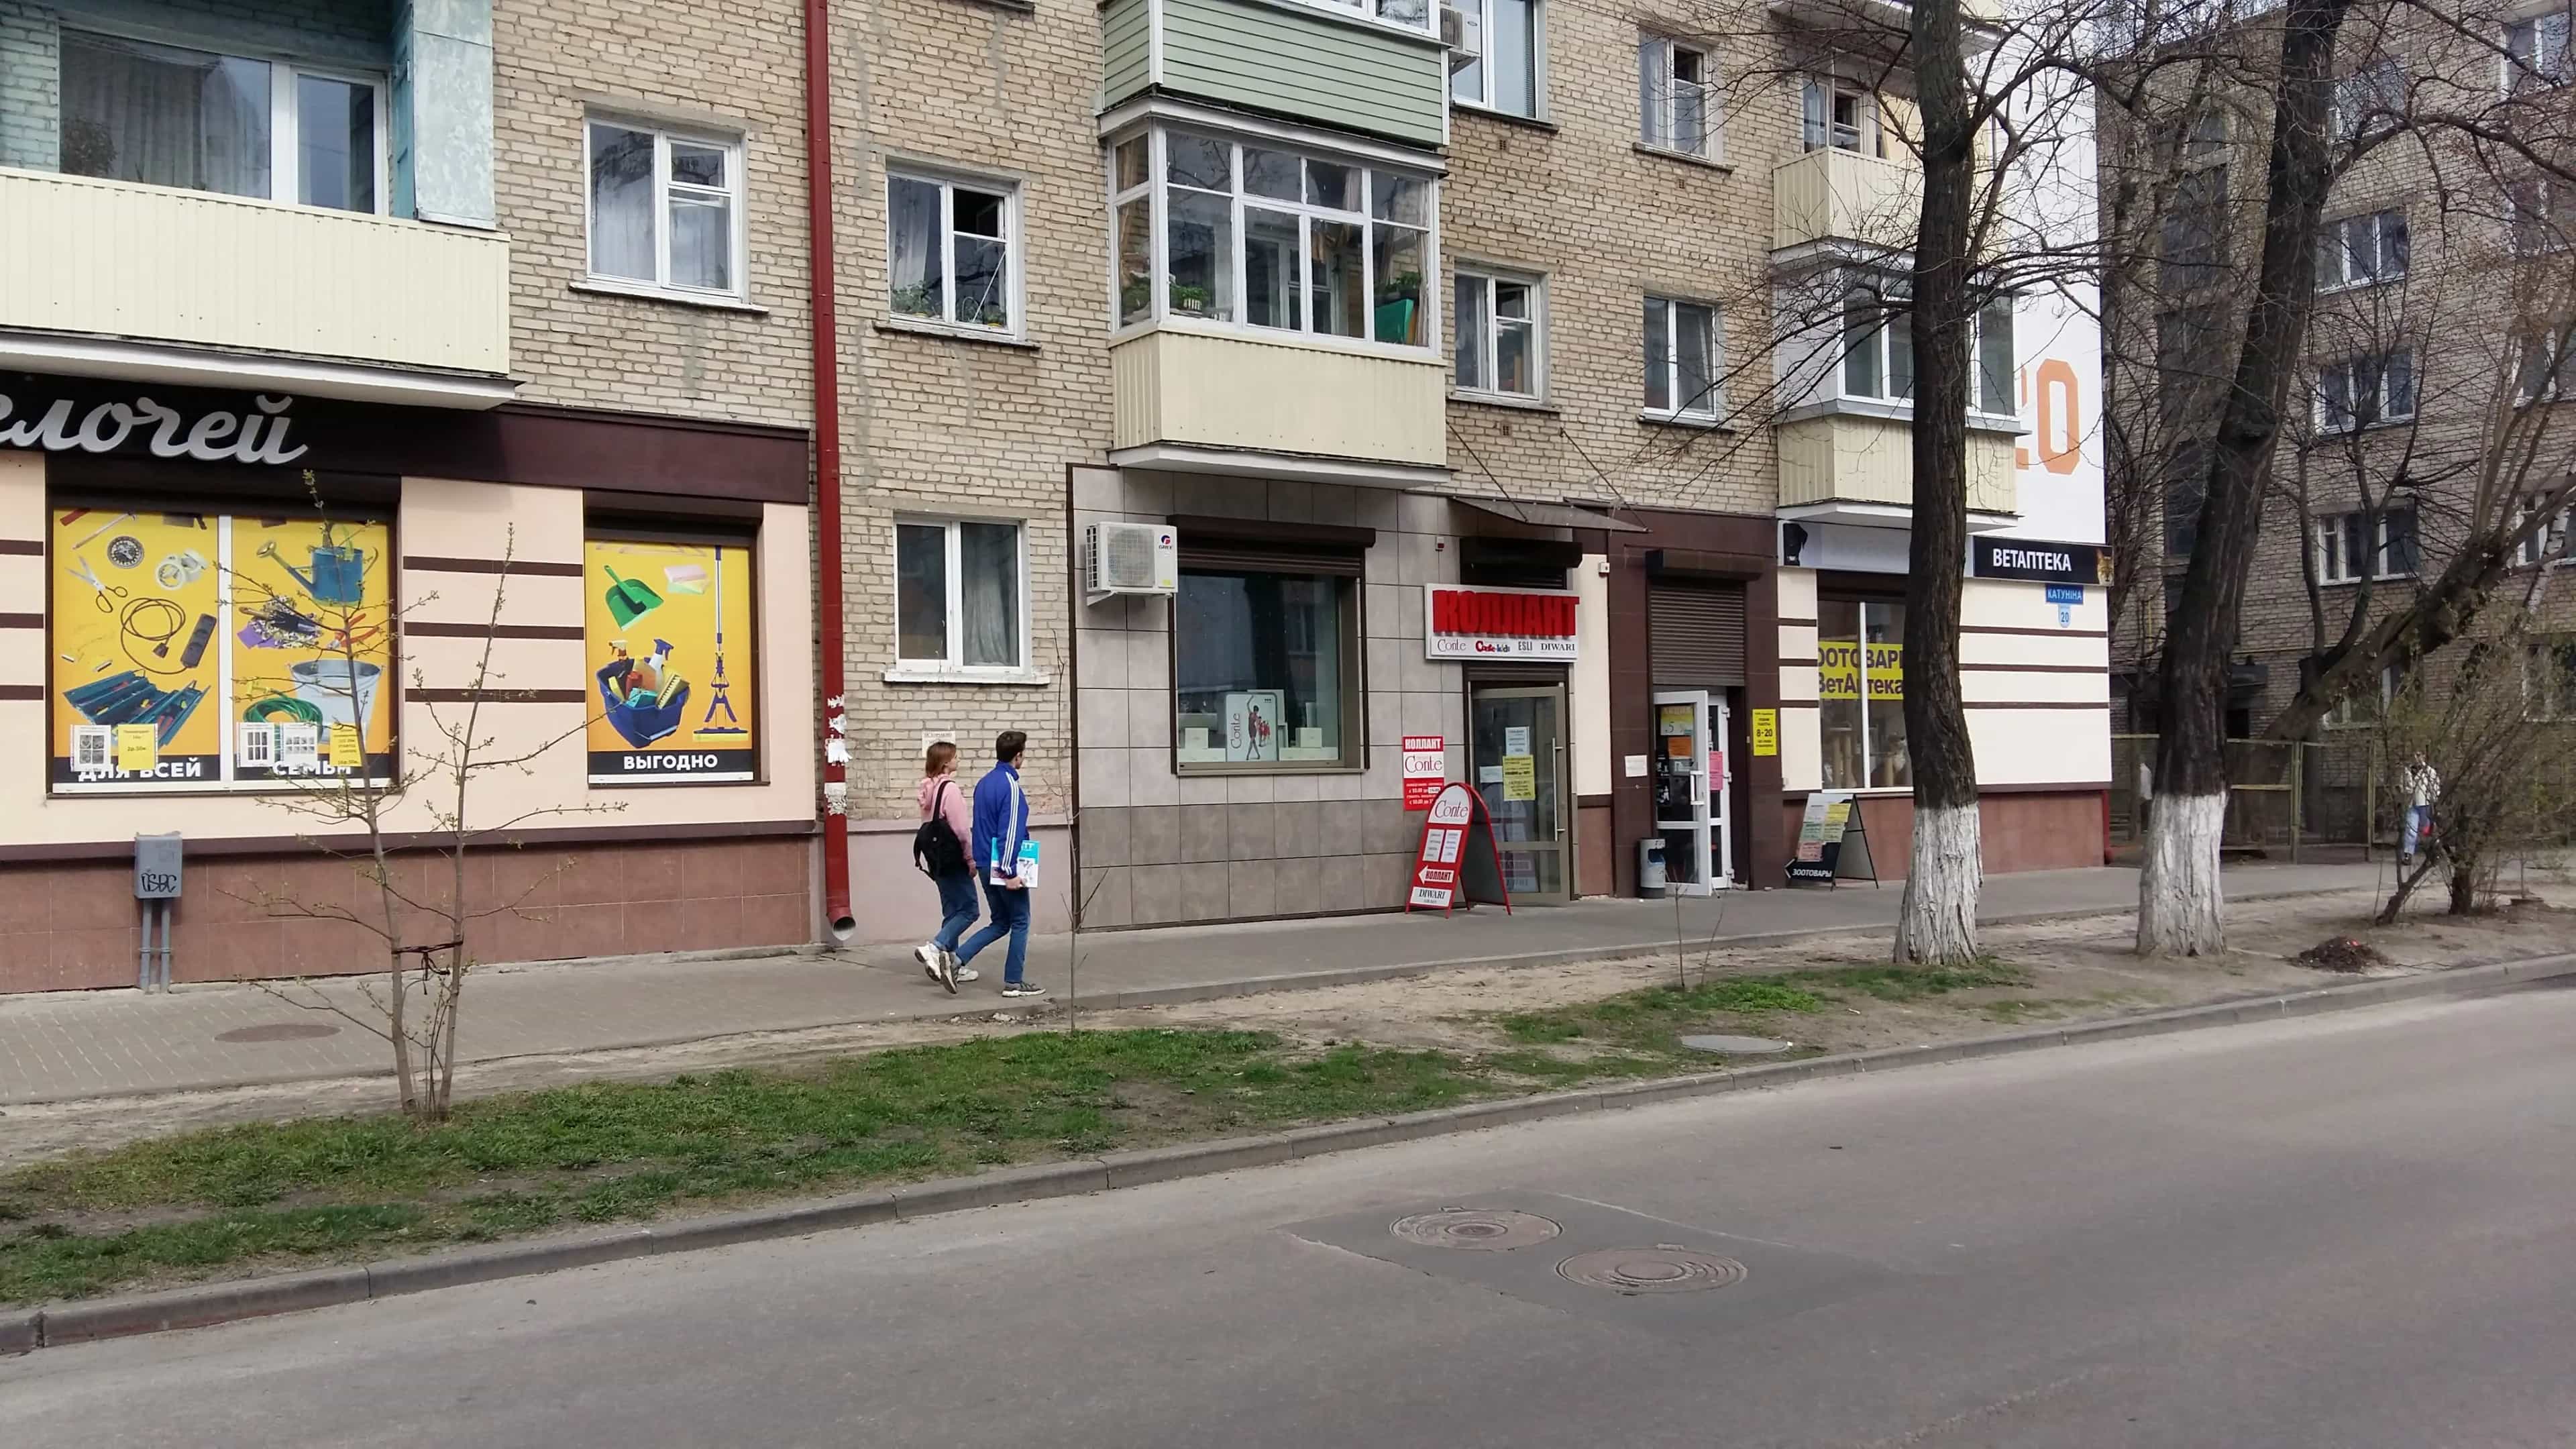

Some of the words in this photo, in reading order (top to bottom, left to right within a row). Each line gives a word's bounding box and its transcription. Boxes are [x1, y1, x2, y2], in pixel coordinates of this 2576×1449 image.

[1992, 548, 2072, 572] ВЕТАПТЕКА
[2047, 588, 2083, 600] КАТУНІНА
[1432, 590, 1580, 637] КОЛЛАНТ
[2060, 611, 2070, 623] 20
[1437, 639, 1466, 652] Conte
[1518, 641, 1533, 651] ESLI
[1540, 643, 1575, 651] DIWARI
[1230, 712, 1242, 749] Conte
[1405, 738, 1442, 750] КОЛЛАНТ
[623, 753, 718, 771] ВЫГОДНО
[1405, 755, 1443, 773] Conte
[1434, 800, 1468, 819] Conte
[1425, 871, 1452, 881] КОЛЛАНТ
[1792, 869, 1833, 877] ЗООТОВАРЫ
[1419, 889, 1446, 900] DIWARI
